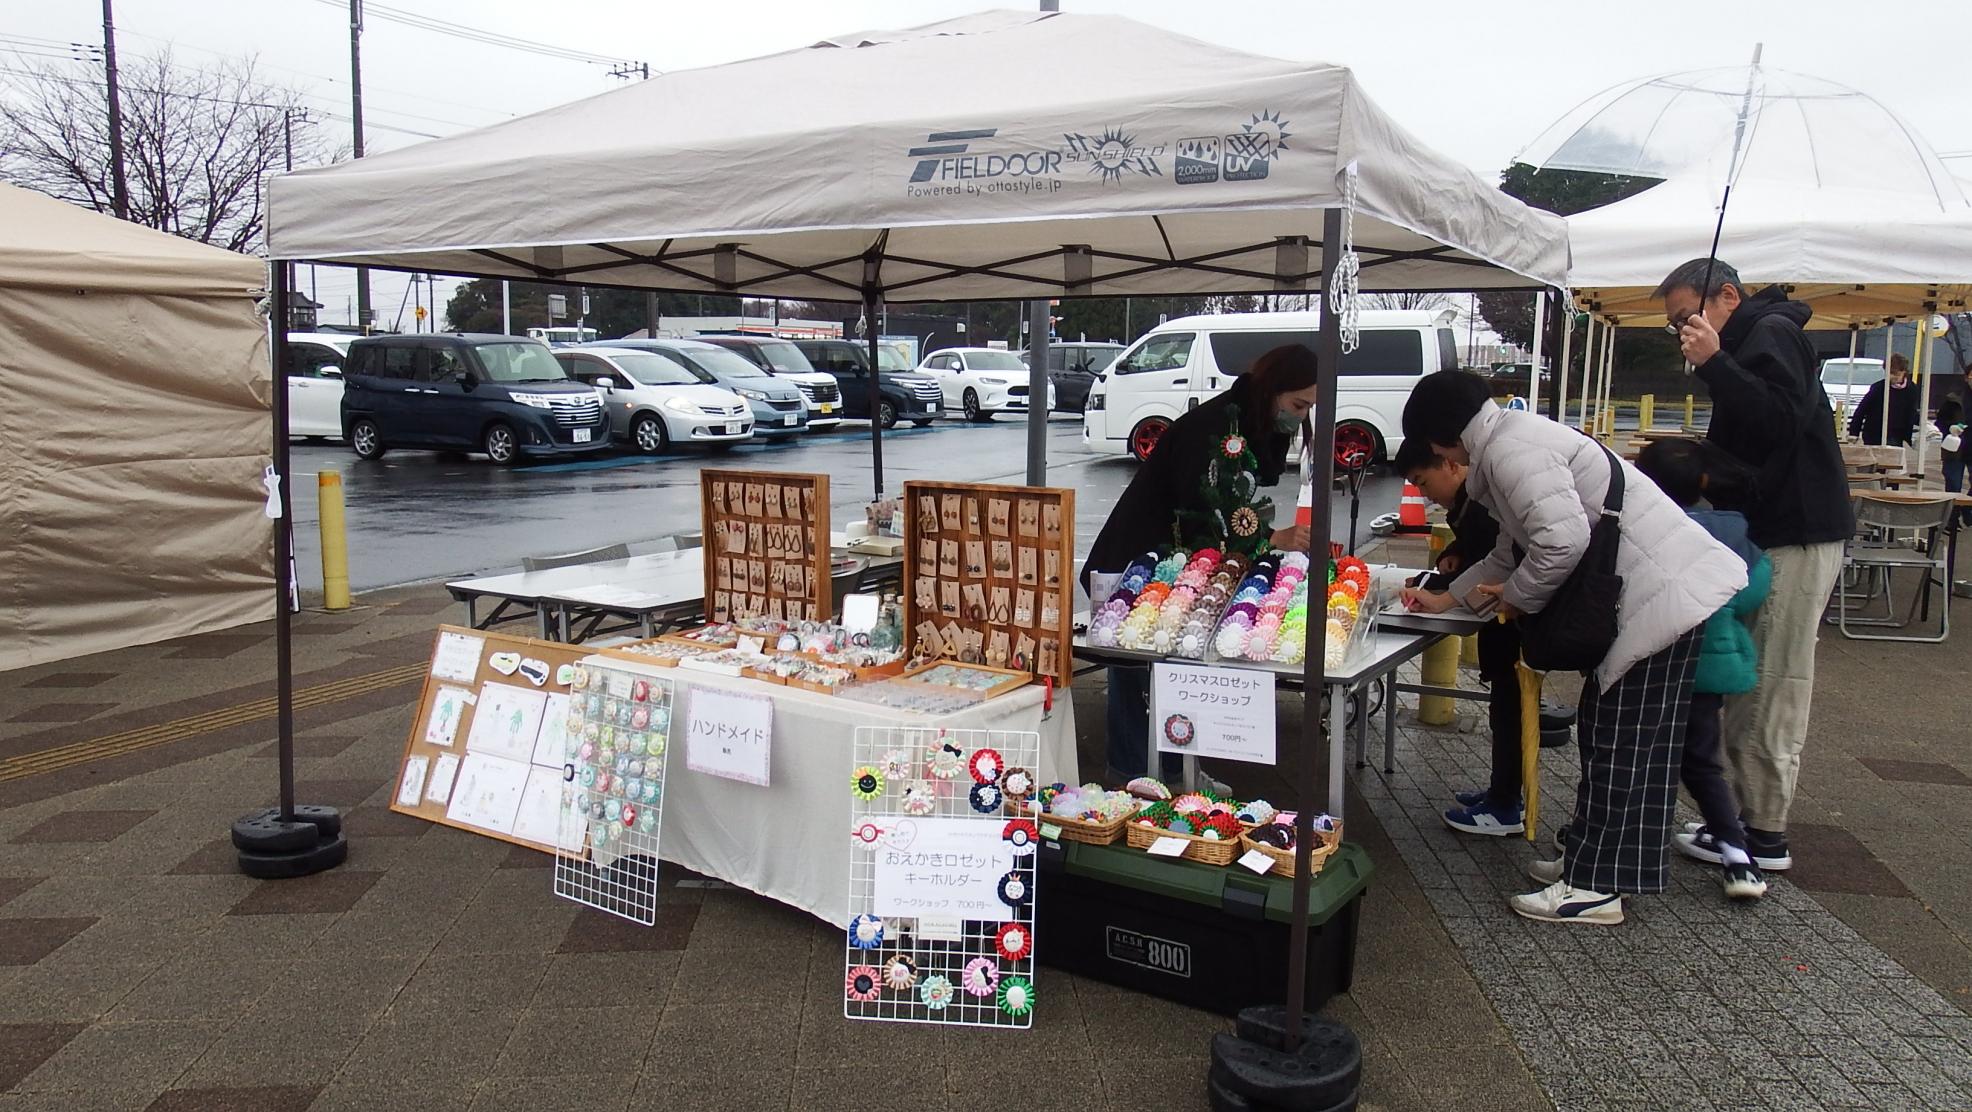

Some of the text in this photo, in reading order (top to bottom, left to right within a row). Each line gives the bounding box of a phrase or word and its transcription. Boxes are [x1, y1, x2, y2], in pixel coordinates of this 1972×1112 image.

[942, 151, 1062, 180] FIELDOOR
[1177, 164, 1217, 176] 2,000mm
[1226, 155, 1256, 173] UV
[907, 176, 1063, 198] Powered by ottostyle.jp
[1168, 671, 1261, 691] クリスマスロゼット
[1178, 690, 1252, 706] ワークショップ
[692, 719, 764, 745] ハンドメイド
[886, 851, 1002, 869] おえかきロゼット
[904, 872, 983, 887] キーホルダー
[893, 897, 949, 908] ワークショップ
[1148, 940, 1185, 972] 800
